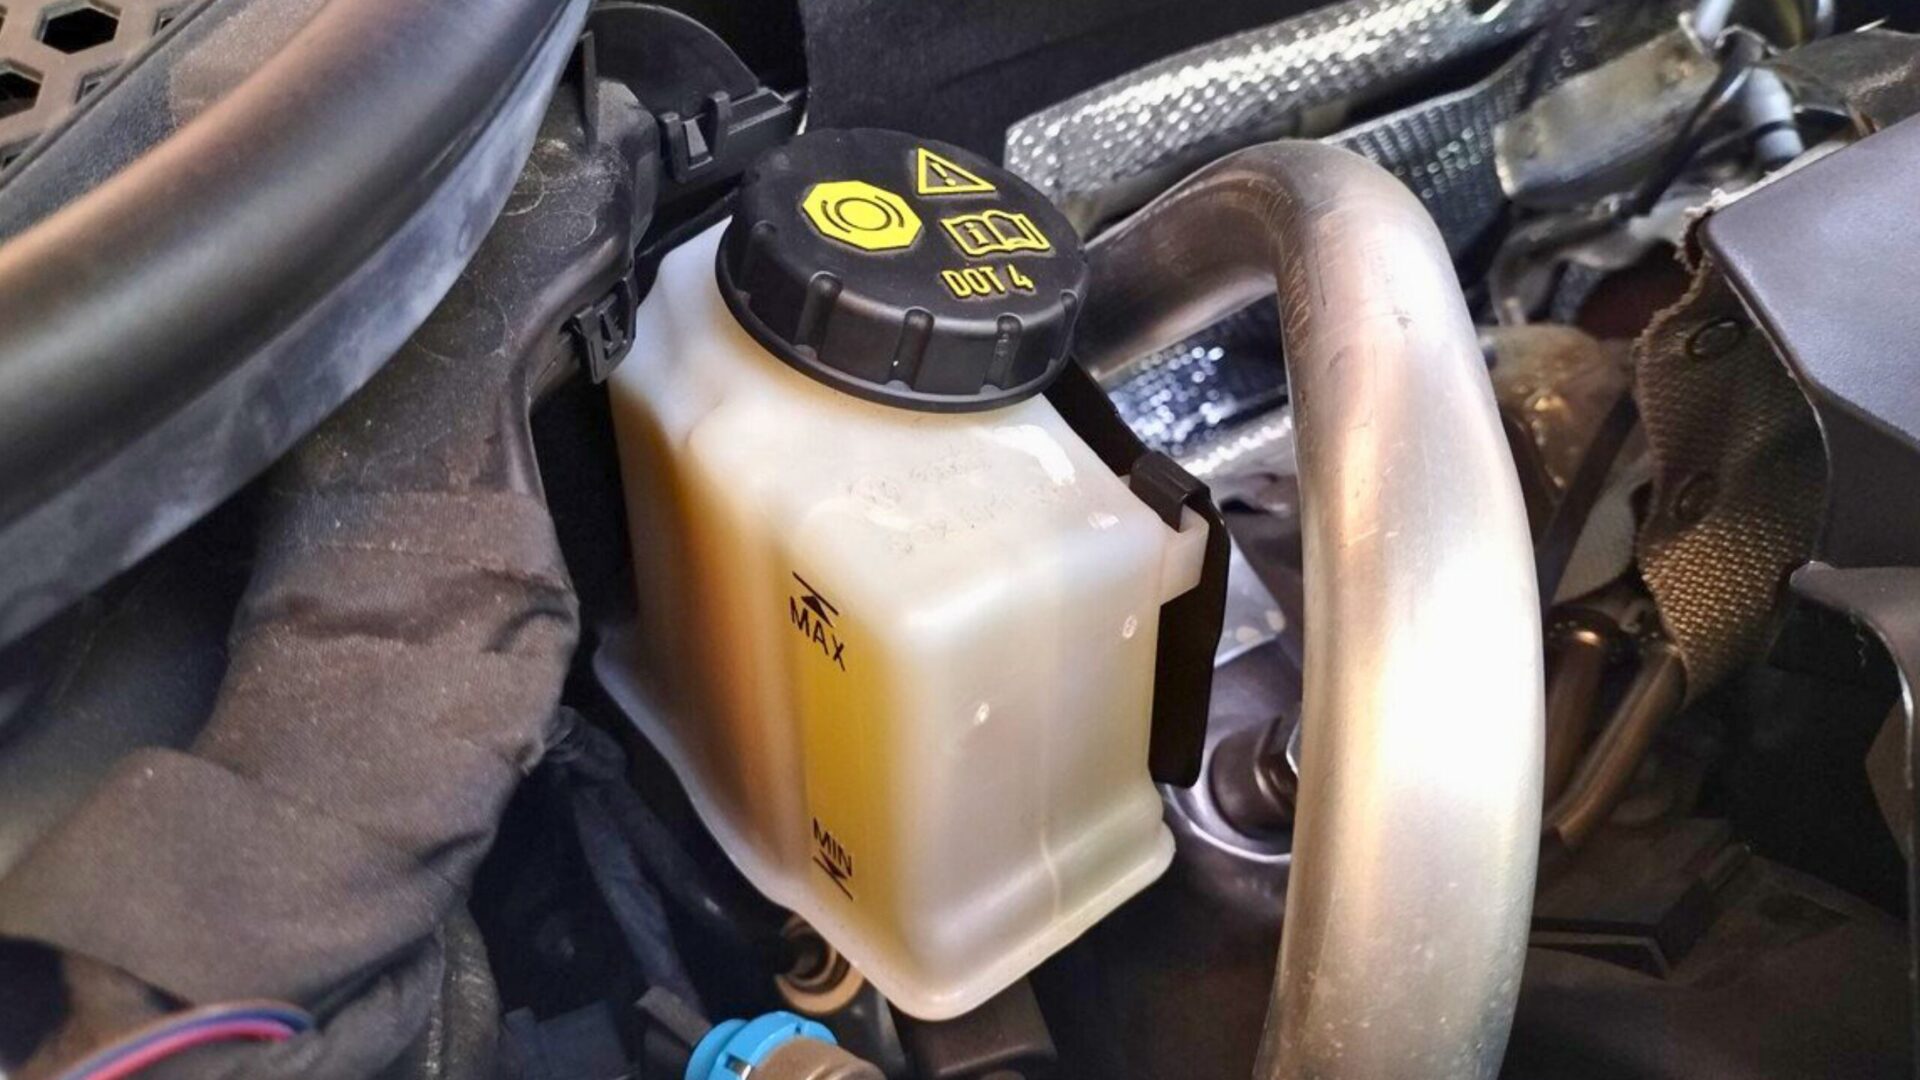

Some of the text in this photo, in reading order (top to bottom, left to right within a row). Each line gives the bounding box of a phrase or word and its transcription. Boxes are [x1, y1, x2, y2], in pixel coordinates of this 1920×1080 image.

[941, 263, 1034, 297] DOT 4
[789, 595, 846, 672] MAX
[812, 817, 853, 877] MIN
